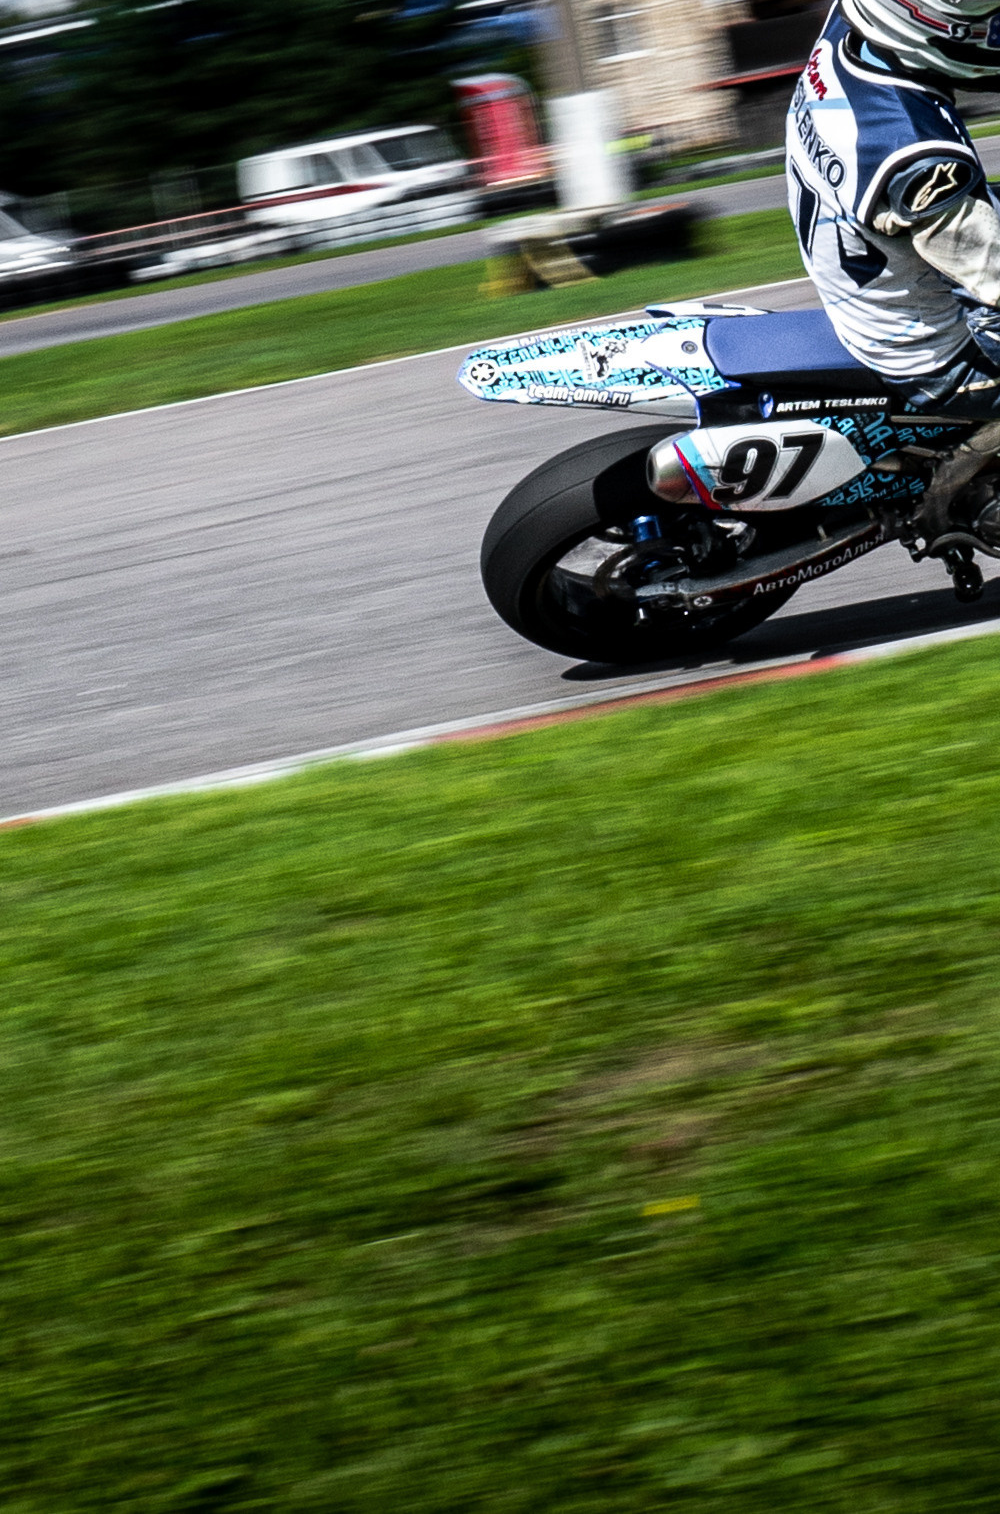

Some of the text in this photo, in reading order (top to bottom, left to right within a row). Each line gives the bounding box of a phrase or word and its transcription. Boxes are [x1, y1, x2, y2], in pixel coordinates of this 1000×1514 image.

[793, 76, 847, 191] SLENKO
[527, 383, 631, 407] team-ama.ru
[776, 397, 888, 413] ARTEM TESLENKO
[711, 429, 827, 504] 97
[753, 533, 885, 596] АвтоМотоАлья
